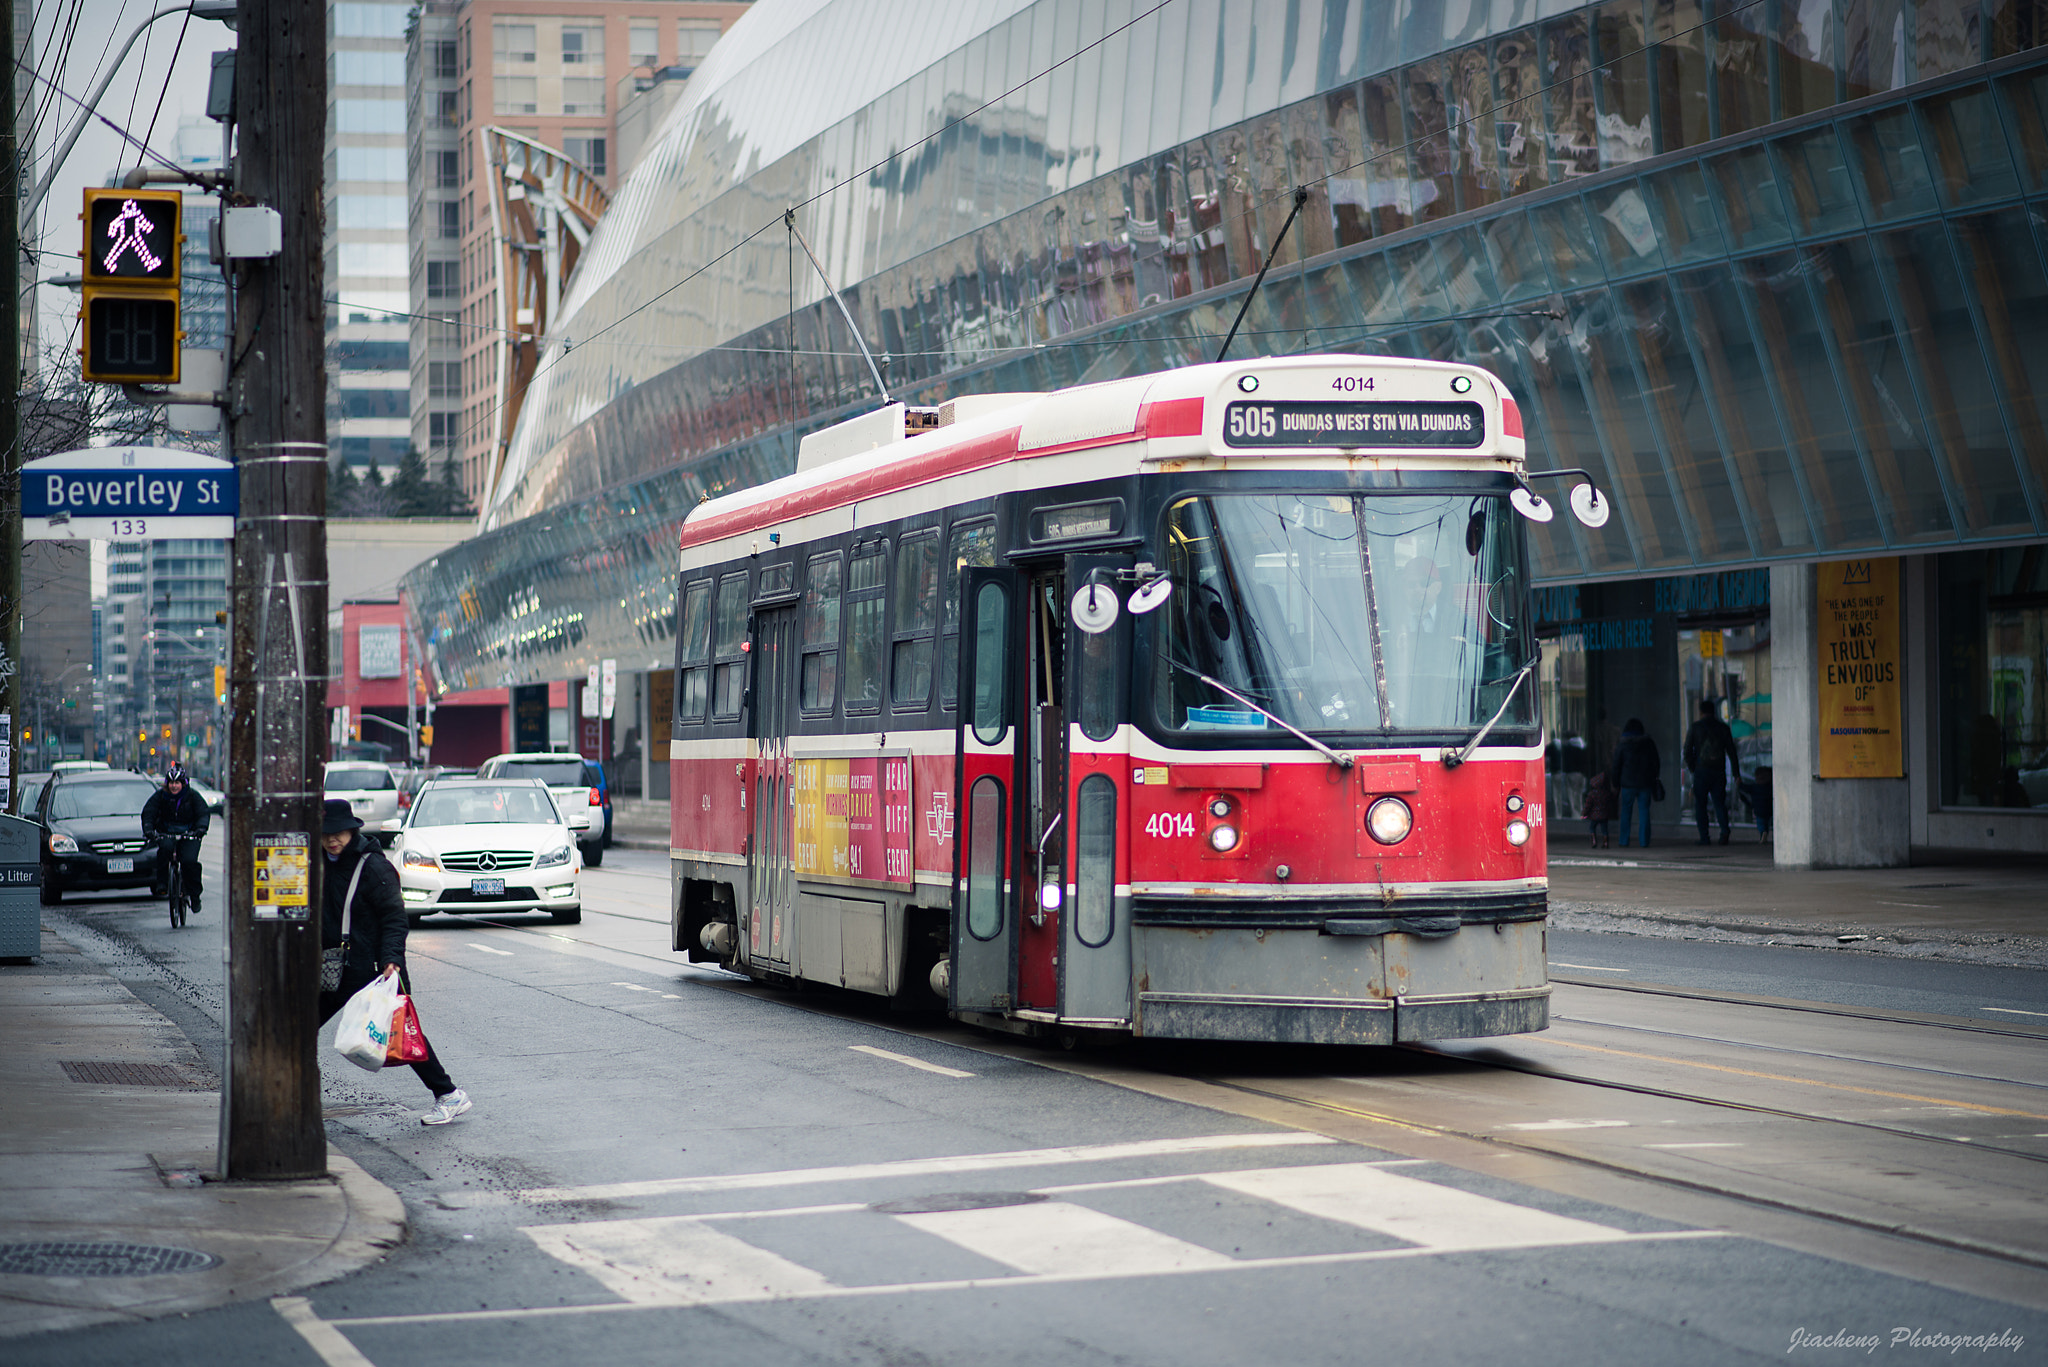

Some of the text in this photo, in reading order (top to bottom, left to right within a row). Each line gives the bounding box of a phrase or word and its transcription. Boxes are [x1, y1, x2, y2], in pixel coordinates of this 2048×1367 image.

[1332, 377, 1375, 392] 4014
[1230, 406, 1472, 437] 505 DUNDAS WEST STN VIA DUNDAS
[47, 473, 220, 513] Beverley St
[111, 520, 147, 536] 133
[1655, 575, 1708, 613] BECOME
[1711, 573, 1720, 609] A
[1840, 598, 1857, 609] WAS
[1859, 596, 1874, 607] ONE
[1875, 595, 1885, 606] OF
[1834, 609, 1879, 621] THE PEOPLE
[1583, 620, 1623, 651] BELONG
[1625, 618, 1654, 649] HERE
[1848, 622, 1873, 638] WAS
[1829, 638, 1877, 662] TRULY
[1828, 662, 1894, 685] ENVIOUS
[1830, 727, 1890, 736] BASQUIATNOW.com
[797, 764, 817, 791] HEAR
[885, 762, 908, 791] HEAR
[797, 803, 816, 829] DIFF
[850, 793, 873, 817] DRIVE
[1527, 803, 1543, 828] 4014
[886, 804, 908, 833] DIFF
[1145, 812, 1195, 838] 4014
[798, 842, 817, 870] ERENT
[850, 844, 862, 875] 94.1
[886, 848, 909, 877] ERENT
[8, 870, 33, 882] Litter
